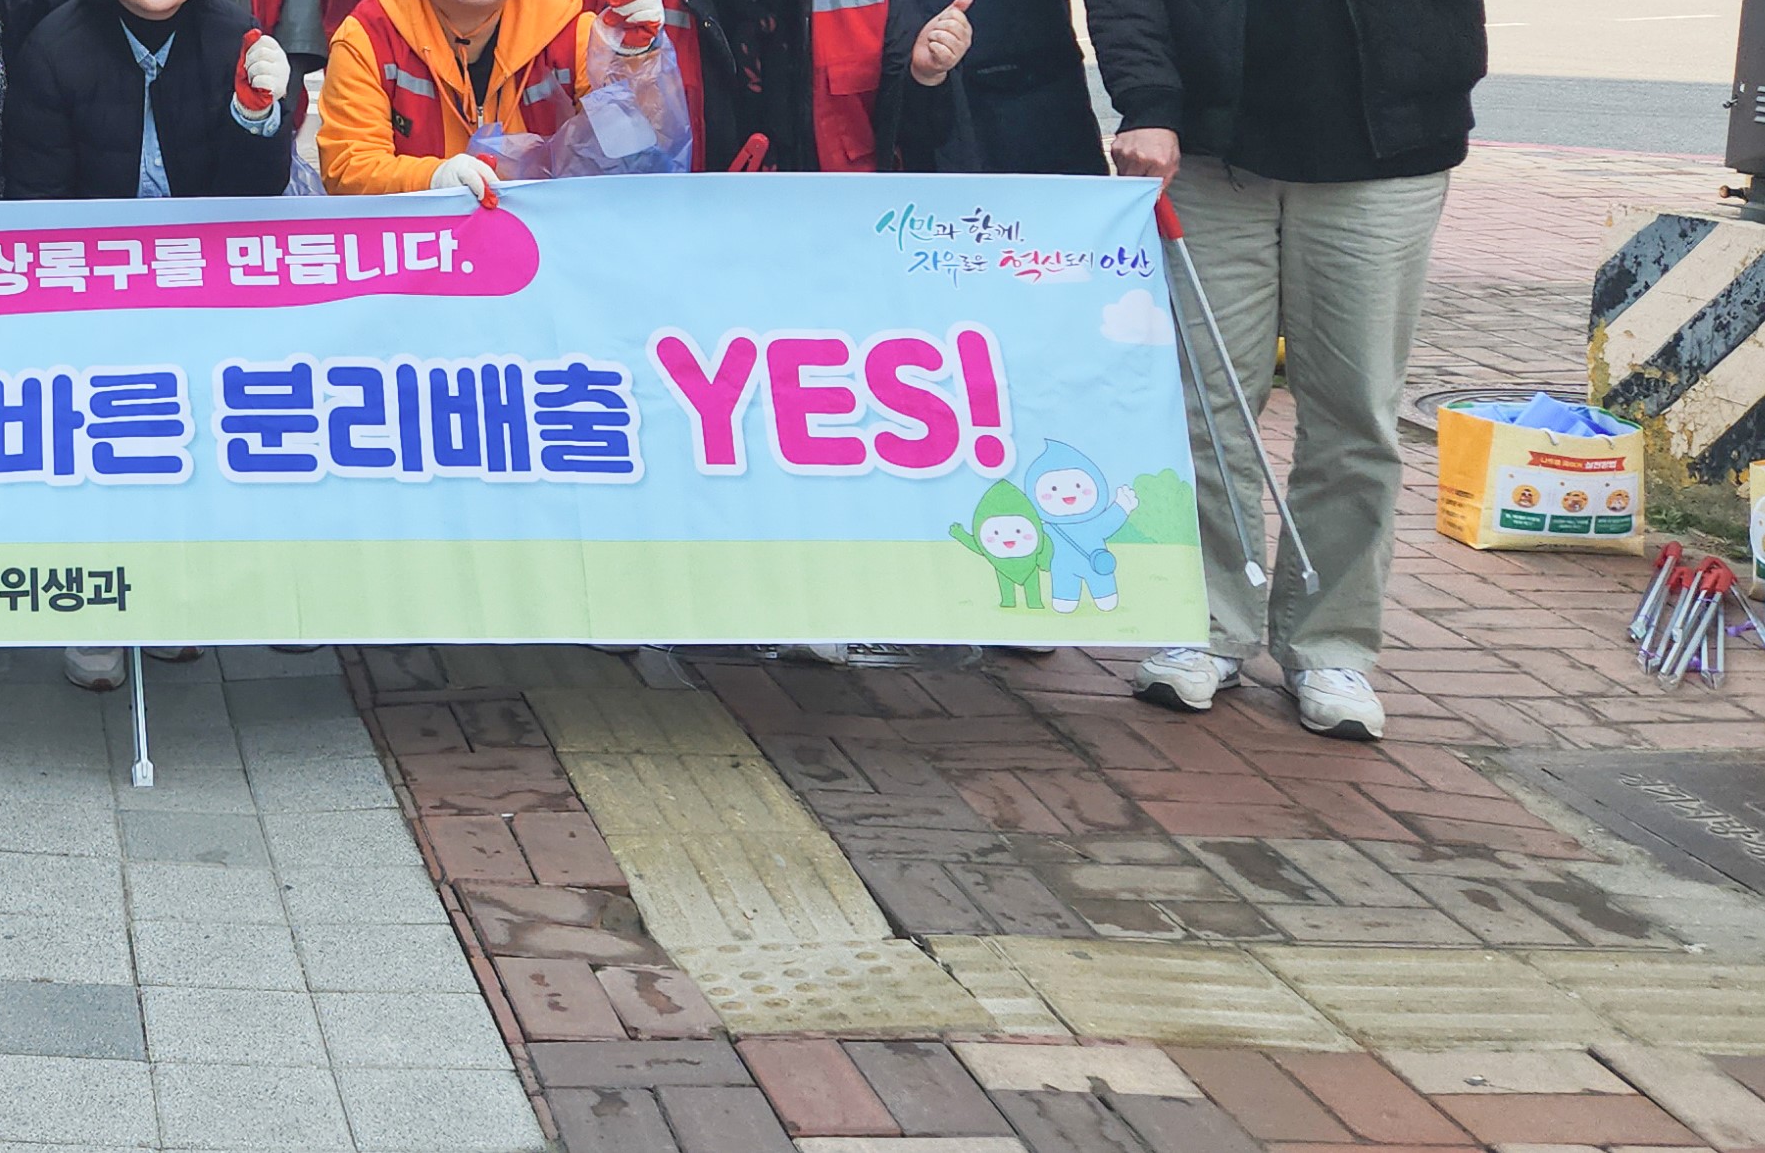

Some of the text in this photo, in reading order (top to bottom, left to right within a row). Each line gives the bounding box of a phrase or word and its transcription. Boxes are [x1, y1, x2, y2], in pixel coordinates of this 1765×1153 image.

[875, 203, 961, 251] 시민과
[225, 228, 474, 286] 만듭니다.
[907, 246, 1156, 289] 자유로운 혁신도시 안산
[219, 361, 635, 475] 분리배출
[654, 329, 1008, 470] YES!
